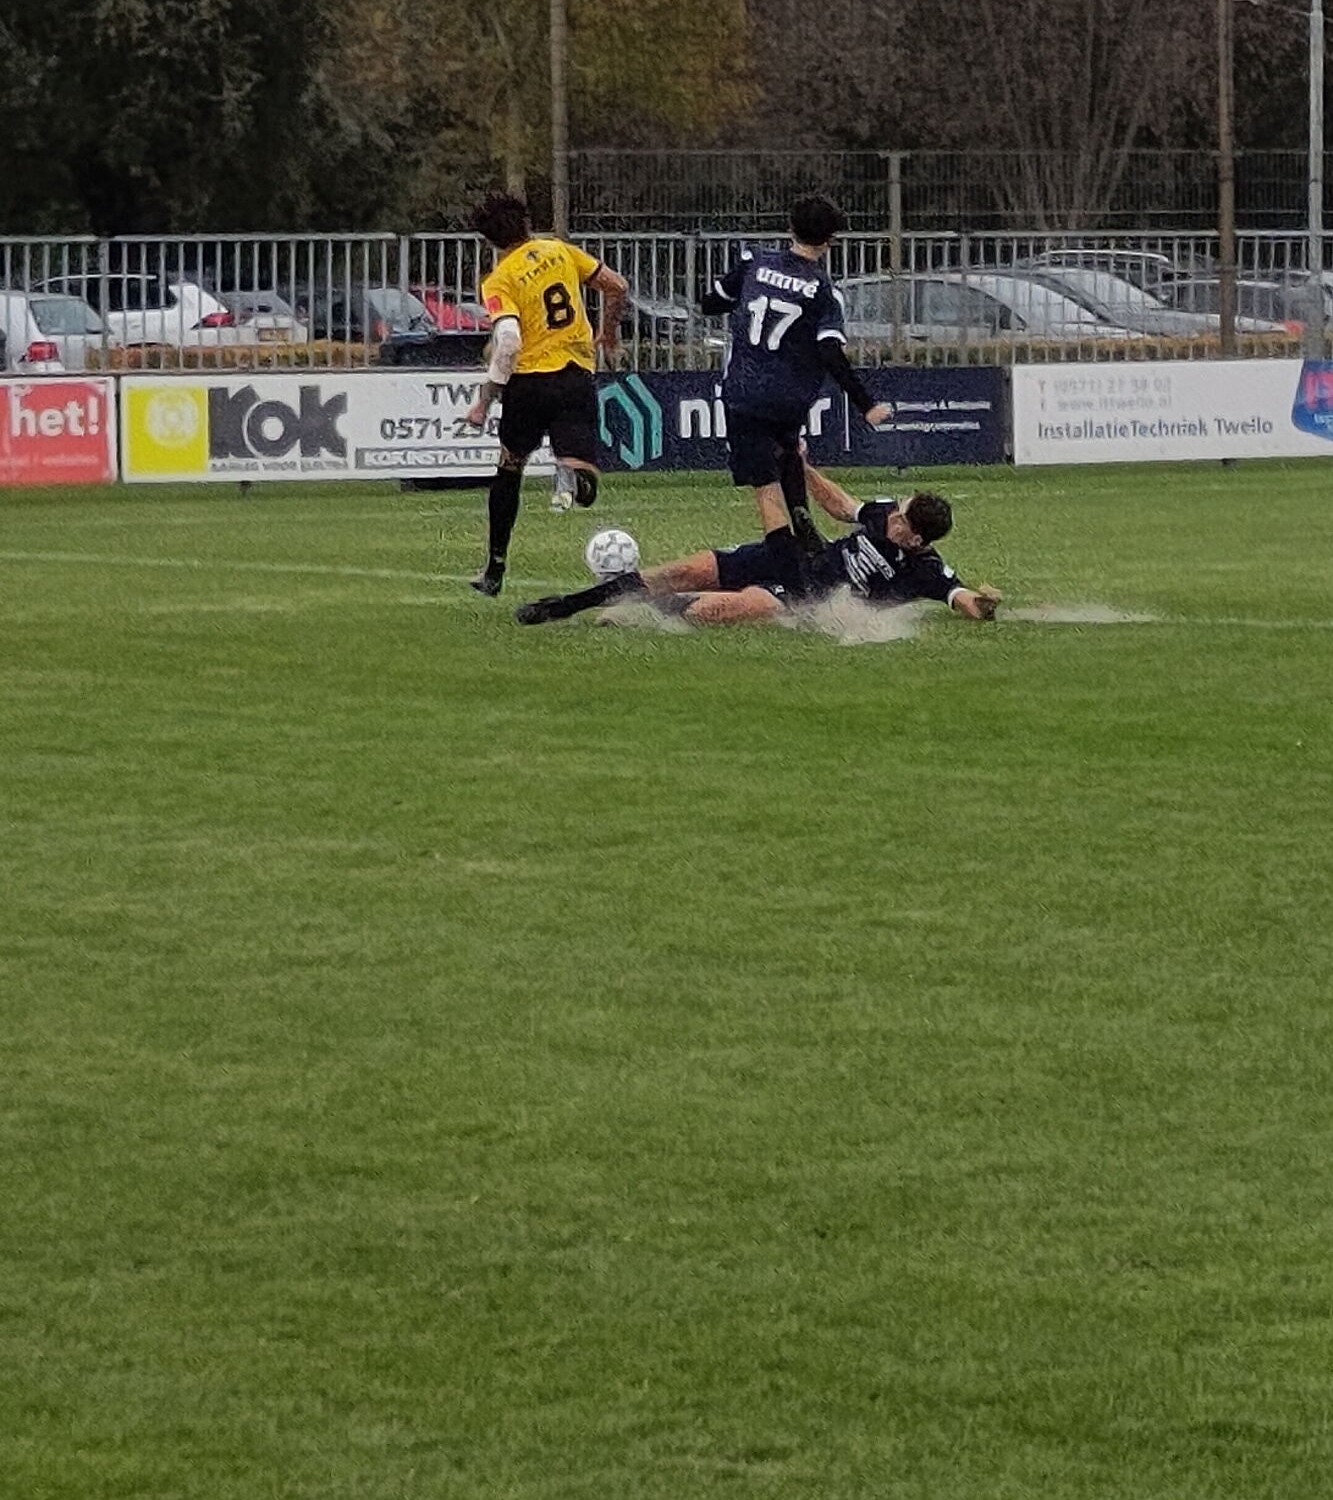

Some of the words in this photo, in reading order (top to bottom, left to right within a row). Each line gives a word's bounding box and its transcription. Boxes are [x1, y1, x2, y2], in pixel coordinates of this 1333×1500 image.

[542, 281, 577, 331] 8
[747, 295, 803, 351] 17
[10, 391, 100, 438] het!
